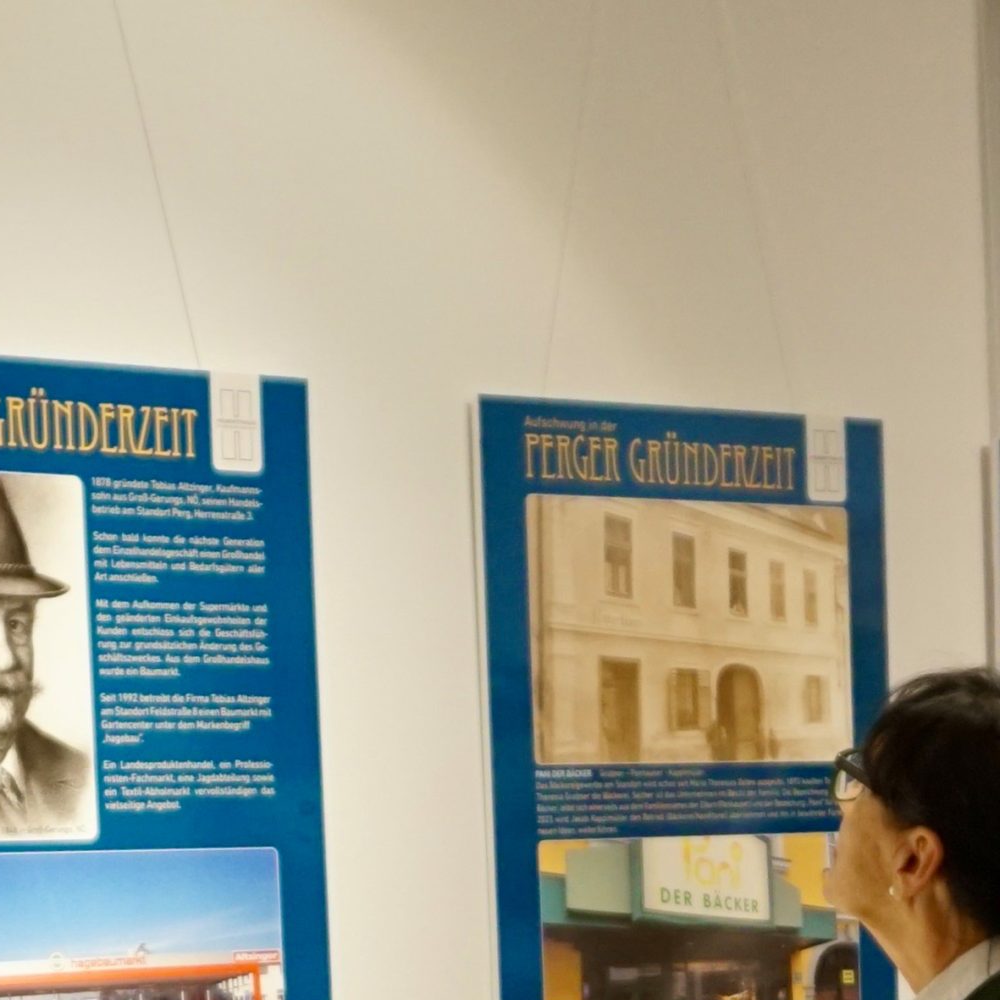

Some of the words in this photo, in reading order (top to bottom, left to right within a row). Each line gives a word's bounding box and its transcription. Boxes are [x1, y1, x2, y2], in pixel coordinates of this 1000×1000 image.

[524, 415, 585, 431] Aufschwung
[588, 419, 598, 431] in
[601, 420, 617, 432] der
[525, 433, 620, 481] PERGER
[629, 431, 795, 490] GRÜNDERZEIT
[660, 887, 693, 906] DER
[703, 890, 759, 913] BÄCKER
